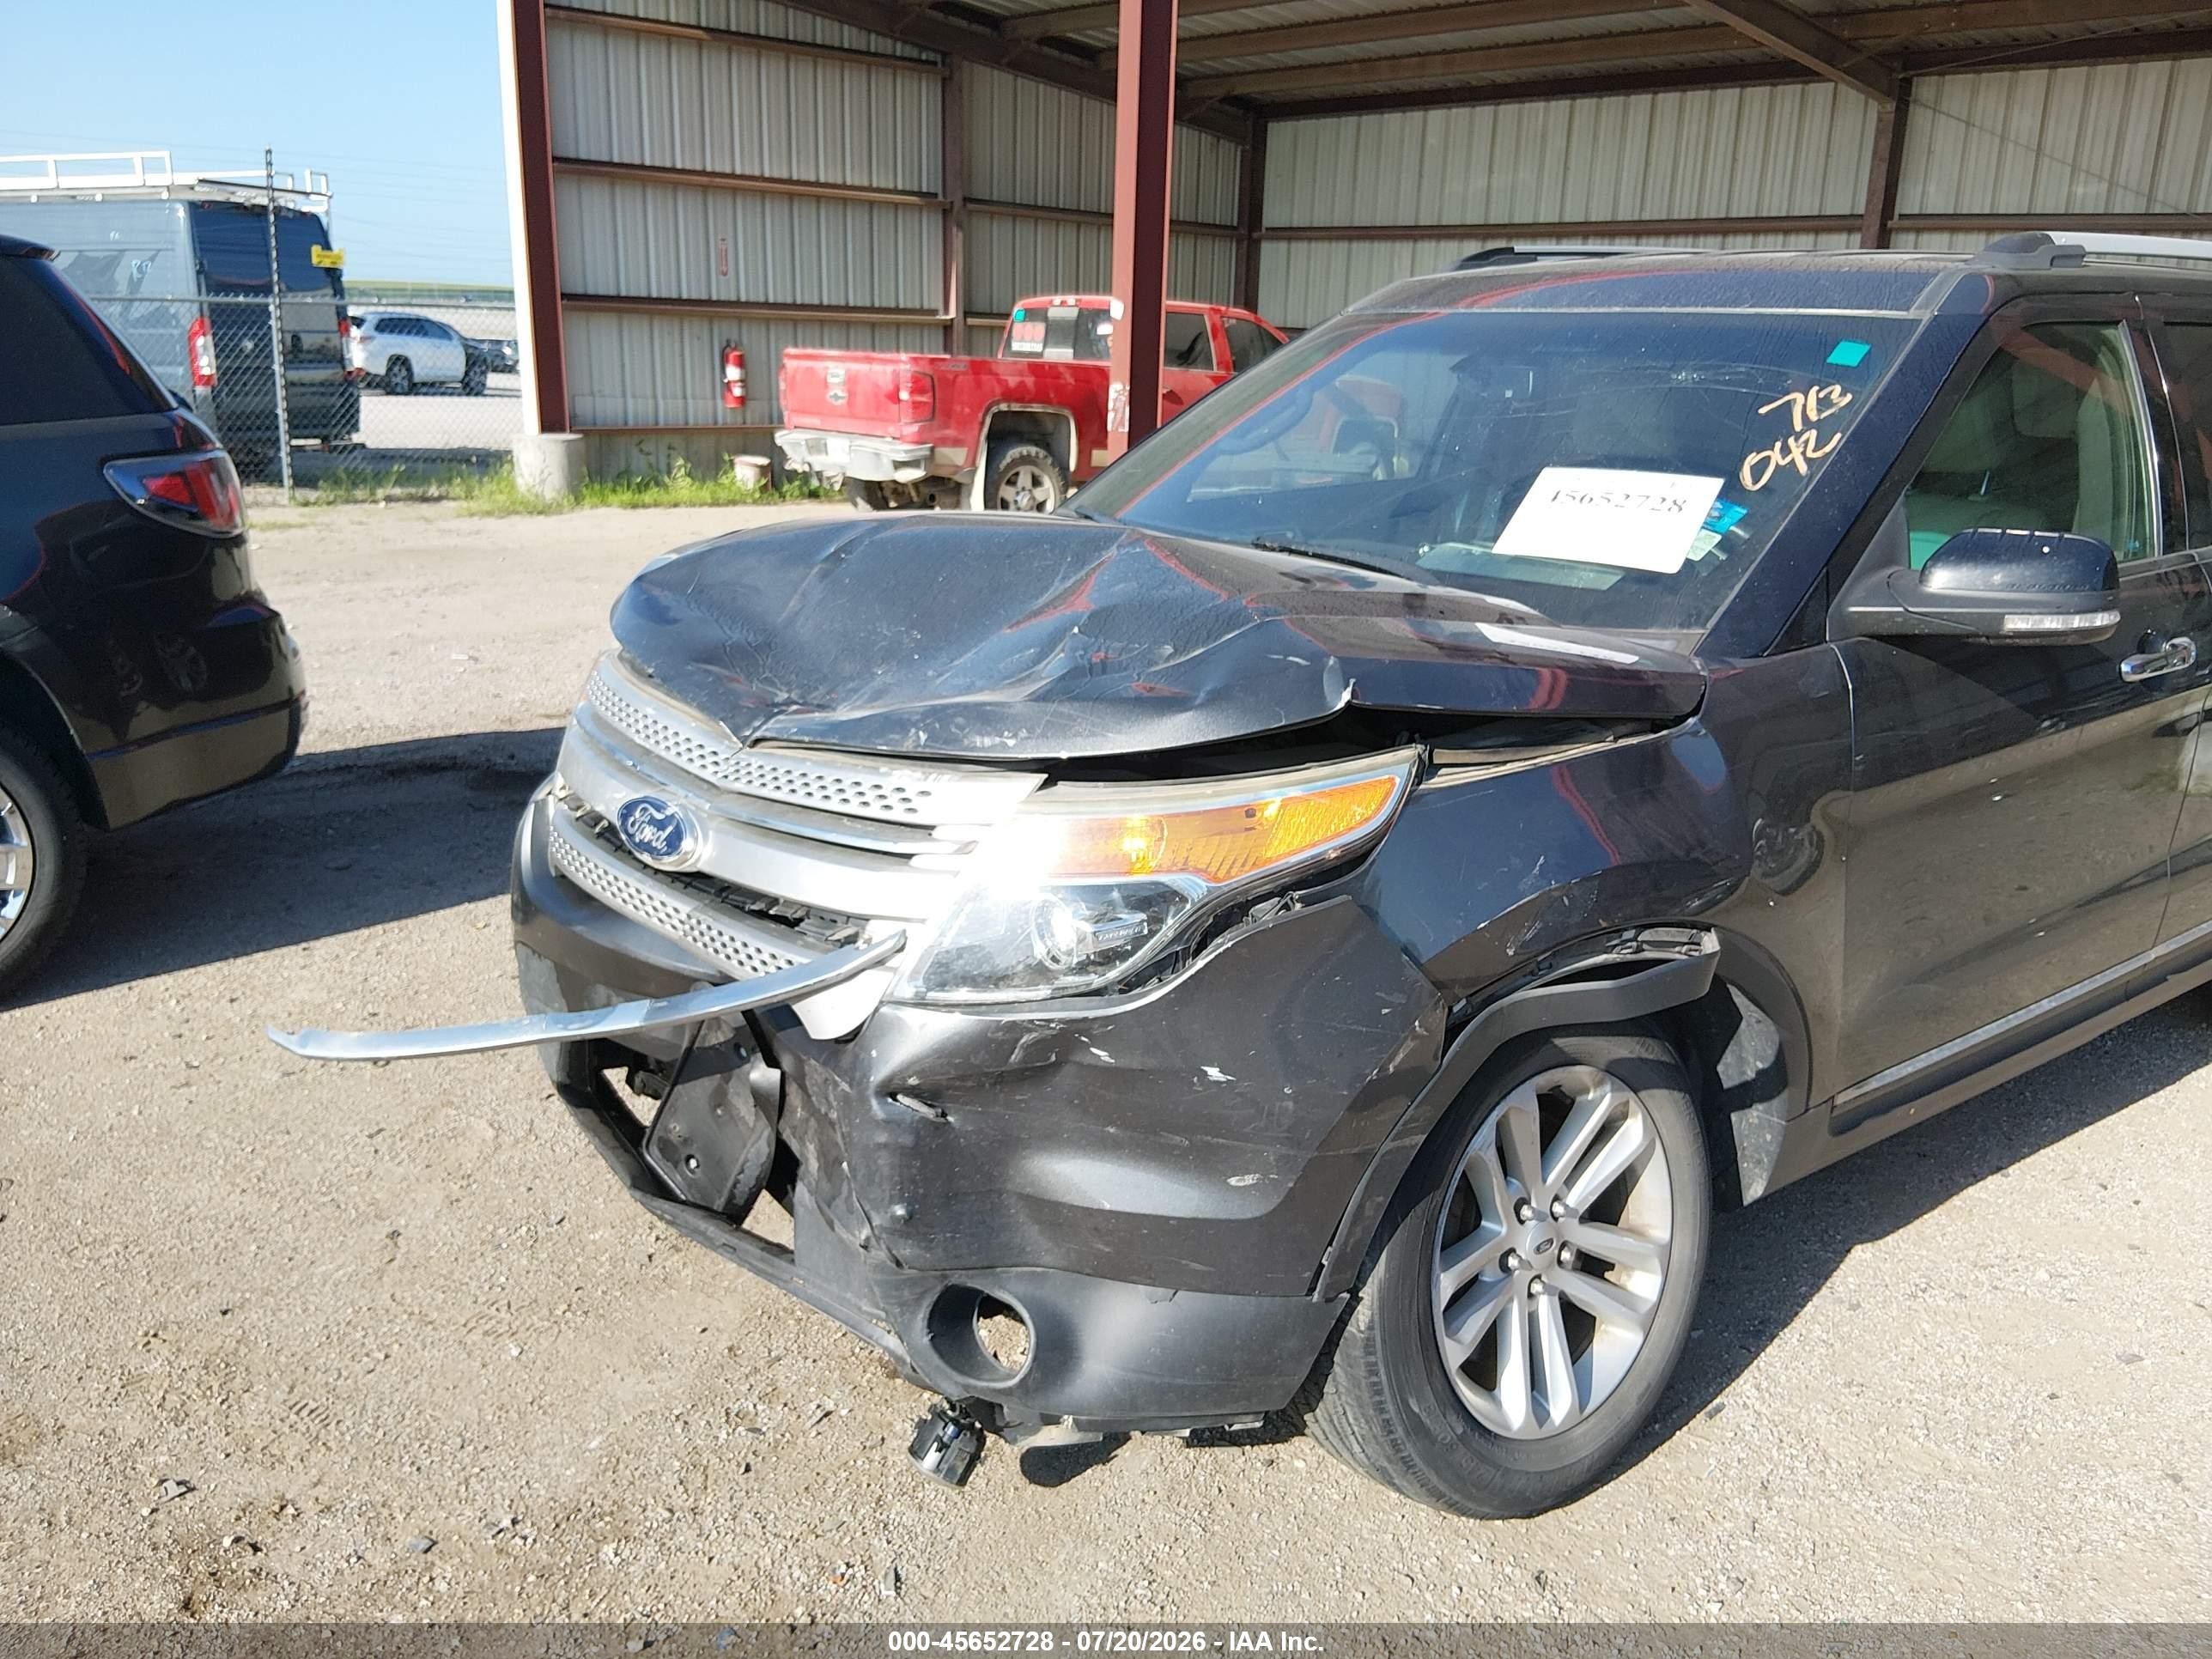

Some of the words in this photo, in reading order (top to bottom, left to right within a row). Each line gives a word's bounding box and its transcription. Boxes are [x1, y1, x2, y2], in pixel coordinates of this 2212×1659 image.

[1757, 384, 1854, 433] 713
[1739, 428, 1843, 492] 042
[625, 801, 677, 854] Ford
